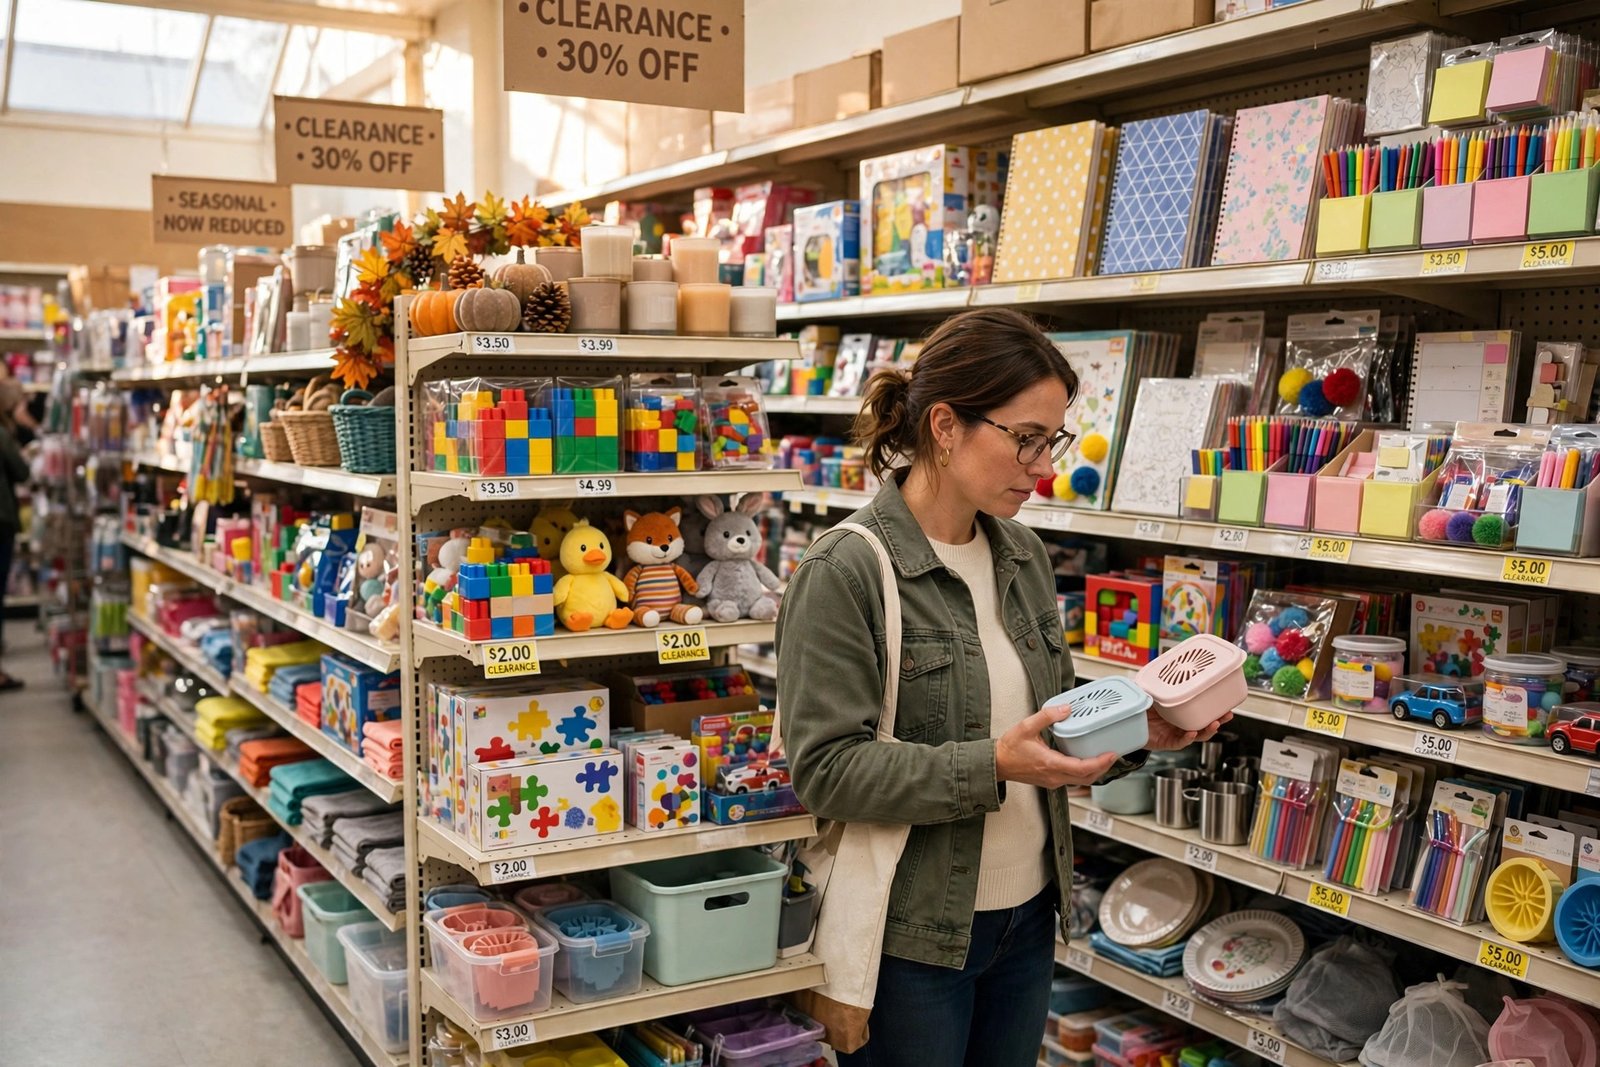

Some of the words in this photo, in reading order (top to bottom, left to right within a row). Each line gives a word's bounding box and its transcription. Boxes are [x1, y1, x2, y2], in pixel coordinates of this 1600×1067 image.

[536, 0, 712, 42] CLEARANCE
[557, 38, 628, 77] 30%
[638, 47, 699, 82] OFF
[296, 116, 424, 145] CLEARANCE
[311, 146, 363, 172] 30%
[369, 150, 413, 174] OFF
[178, 191, 267, 212] SEASONAL
[163, 214, 205, 232] NOW
[208, 216, 285, 236] REDUCED
[1530, 243, 1567, 259] $5.00
[476, 336, 510, 349] $3.50
[581, 338, 613, 351] $3.99
[480, 481, 514, 494] $3.50
[579, 479, 612, 492] $4.99
[1316, 539, 1346, 553] $5.00
[1511, 559, 1546, 575] $5.00
[1503, 573, 1546, 584] CLEARANCE
[662, 632, 701, 649] $2.00
[489, 645, 531, 663] $2.00
[661, 648, 706, 661] CLEARANCE
[487, 662, 536, 675] CLEARANCE
[1312, 710, 1340, 727] $5.00
[1422, 734, 1452, 751] $5.00
[494, 859, 527, 875] $2.00
[1315, 886, 1343, 905] $5.00
[1488, 944, 1522, 967] $5.00
[1480, 956, 1522, 977] CLEARANCE
[495, 1023, 528, 1040] $3.00
